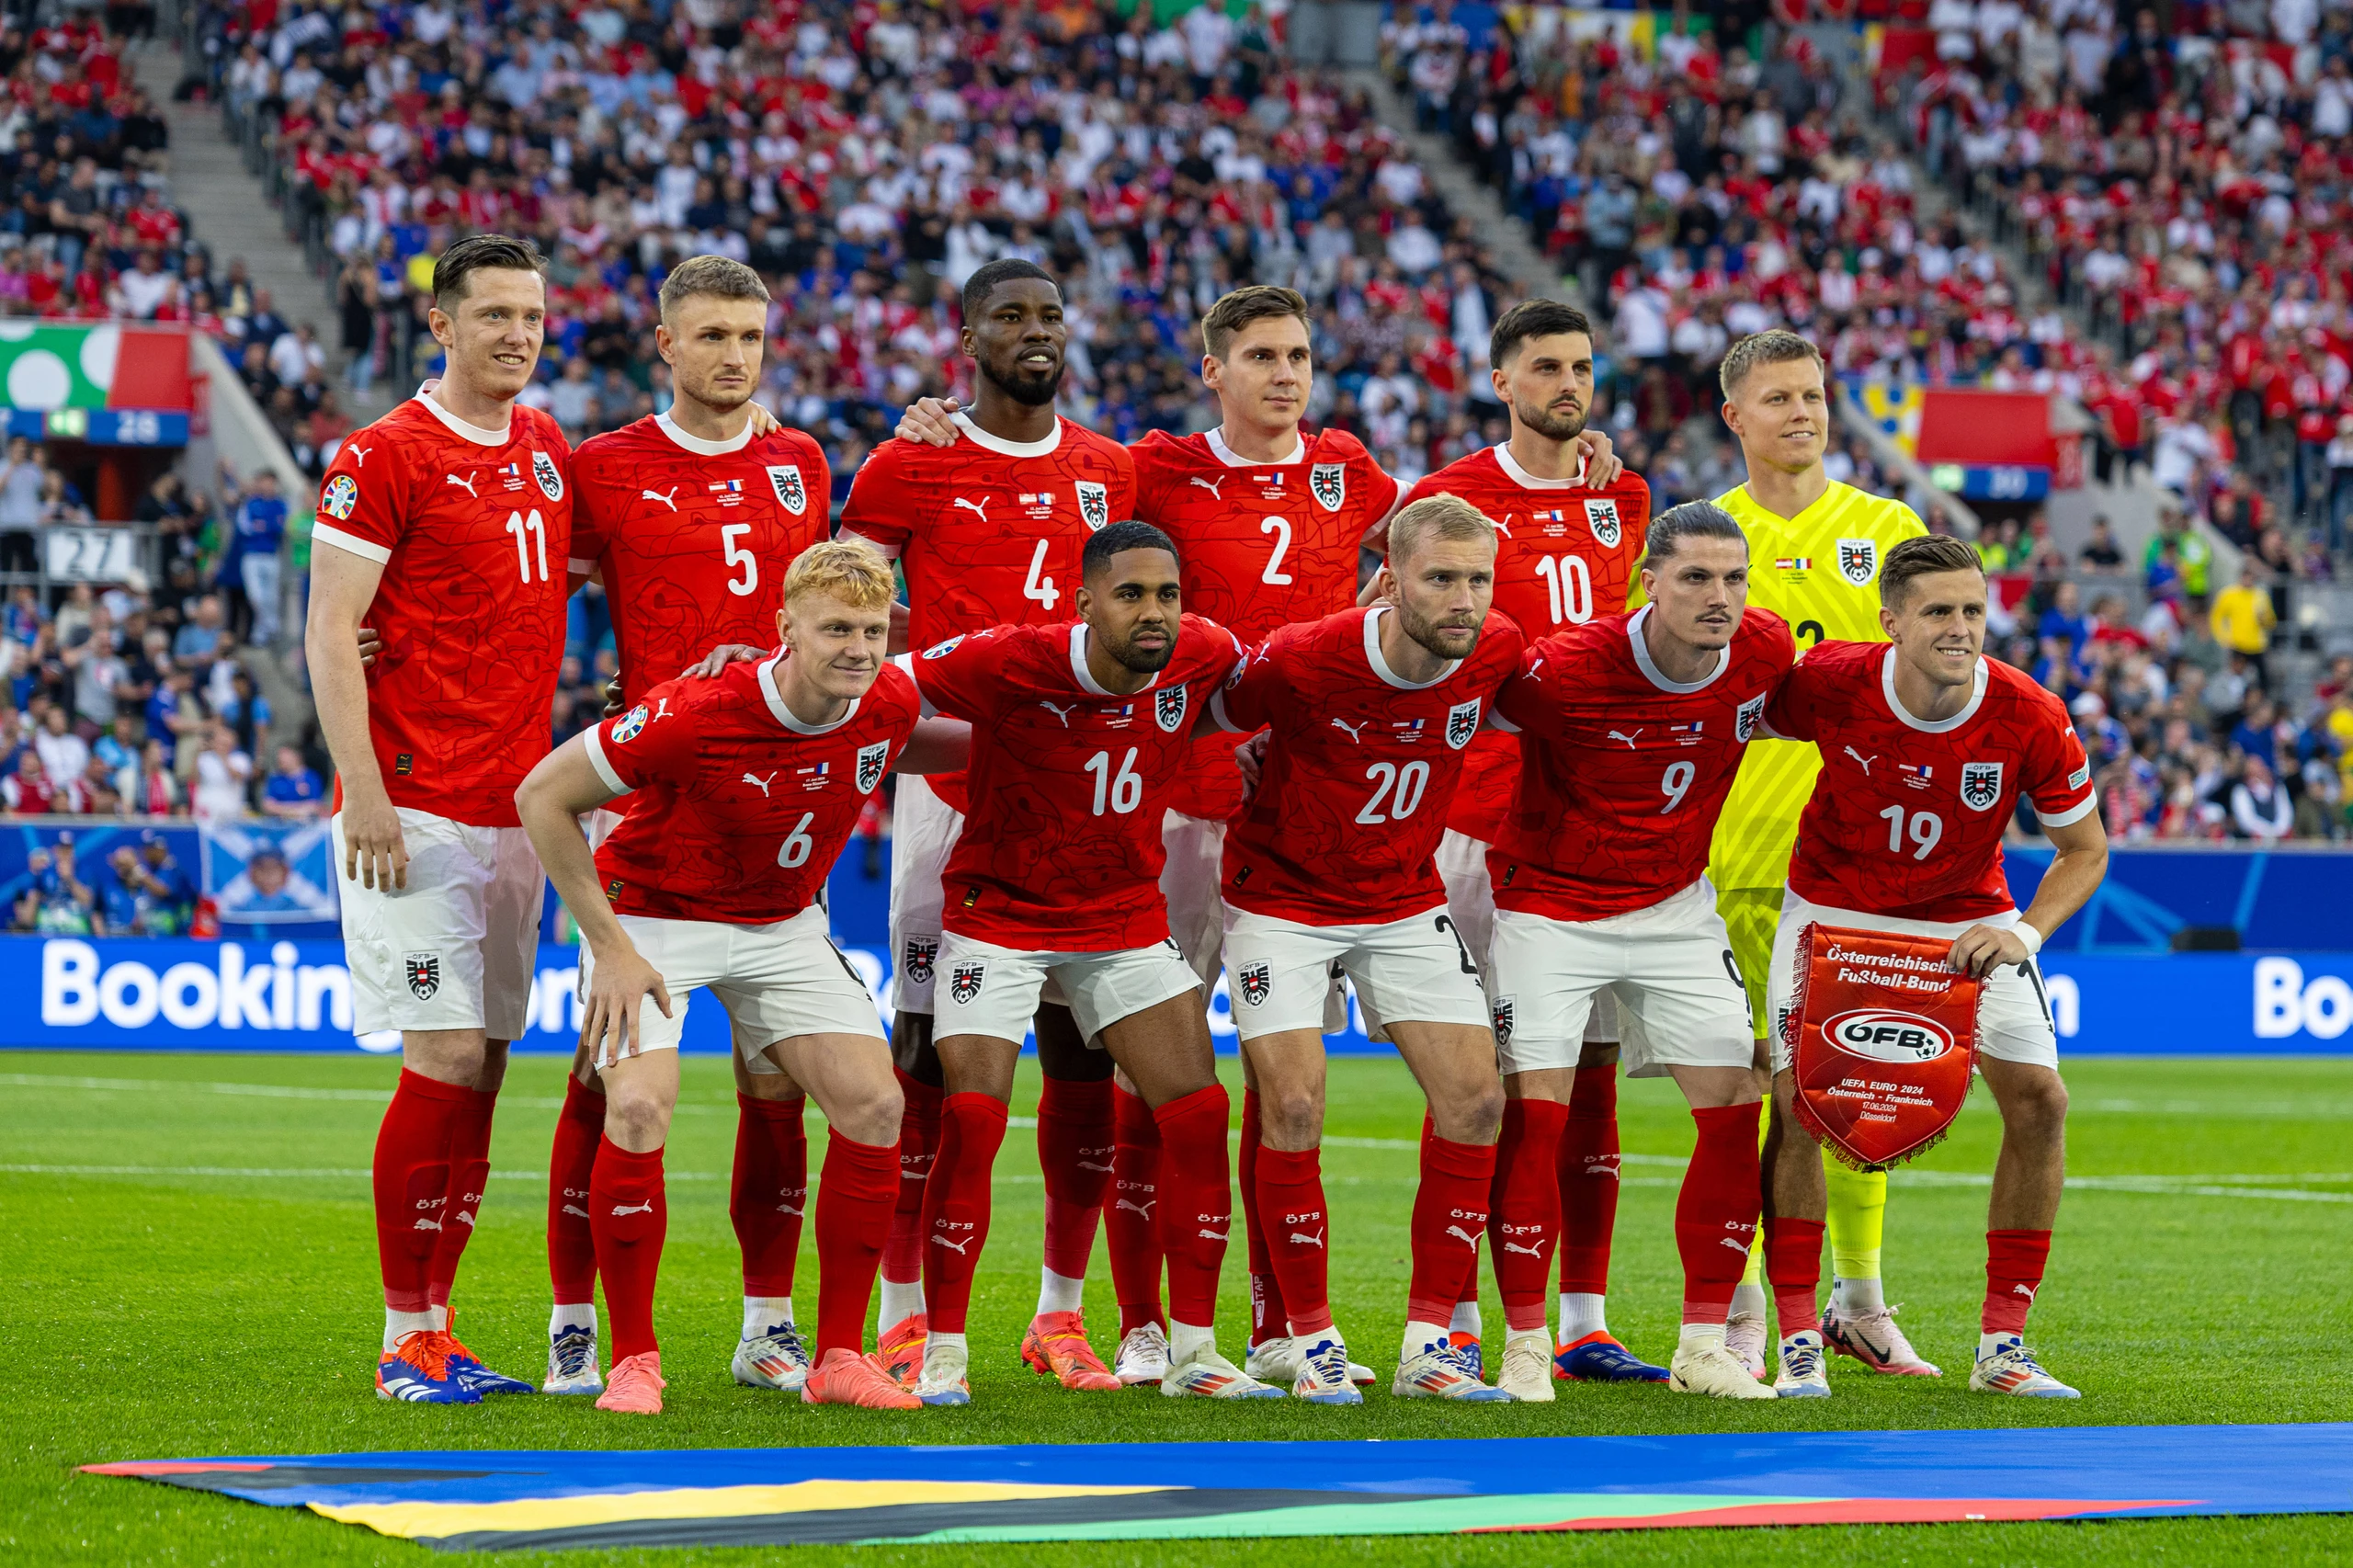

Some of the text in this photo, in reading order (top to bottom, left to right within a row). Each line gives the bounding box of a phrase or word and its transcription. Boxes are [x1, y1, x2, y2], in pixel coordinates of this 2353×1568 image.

[68, 529, 114, 571] 27
[506, 509, 548, 584] 11
[1261, 516, 1292, 585] 2
[722, 523, 757, 597] 5
[1024, 539, 1060, 610] 4
[1535, 555, 1593, 624] 10
[1085, 747, 1142, 816] 16
[1356, 761, 1430, 824] 20
[1661, 761, 1695, 814] 9
[778, 812, 813, 868] 6
[1881, 805, 1942, 860] 19
[1435, 915, 1478, 974] 2
[1826, 944, 1961, 974] Österreichische
[1837, 968, 1951, 993] Fußball-Bund
[1827, 1086, 1875, 1100] Österreich
[1885, 1095, 1933, 1107] Frankreich
[1841, 1078, 1924, 1095] UEFA EURO 2024
[1859, 1112, 1897, 1123] Düsseldorf
[1862, 1101, 1897, 1112] 17.06.2024
[900, 1154, 936, 1164] ÖFB
[1078, 1145, 1115, 1156] ÖFB
[563, 1187, 589, 1199] ÖF
[1117, 1179, 1154, 1192] ÖFB
[416, 1197, 448, 1210] ÖFB
[463, 1192, 483, 1204] ÖF
[936, 1218, 974, 1231] ÖFB
[1285, 1211, 1320, 1224] ÖFB
[1450, 1209, 1487, 1221] ÖFB
[1501, 1224, 1541, 1236] ÖFB
